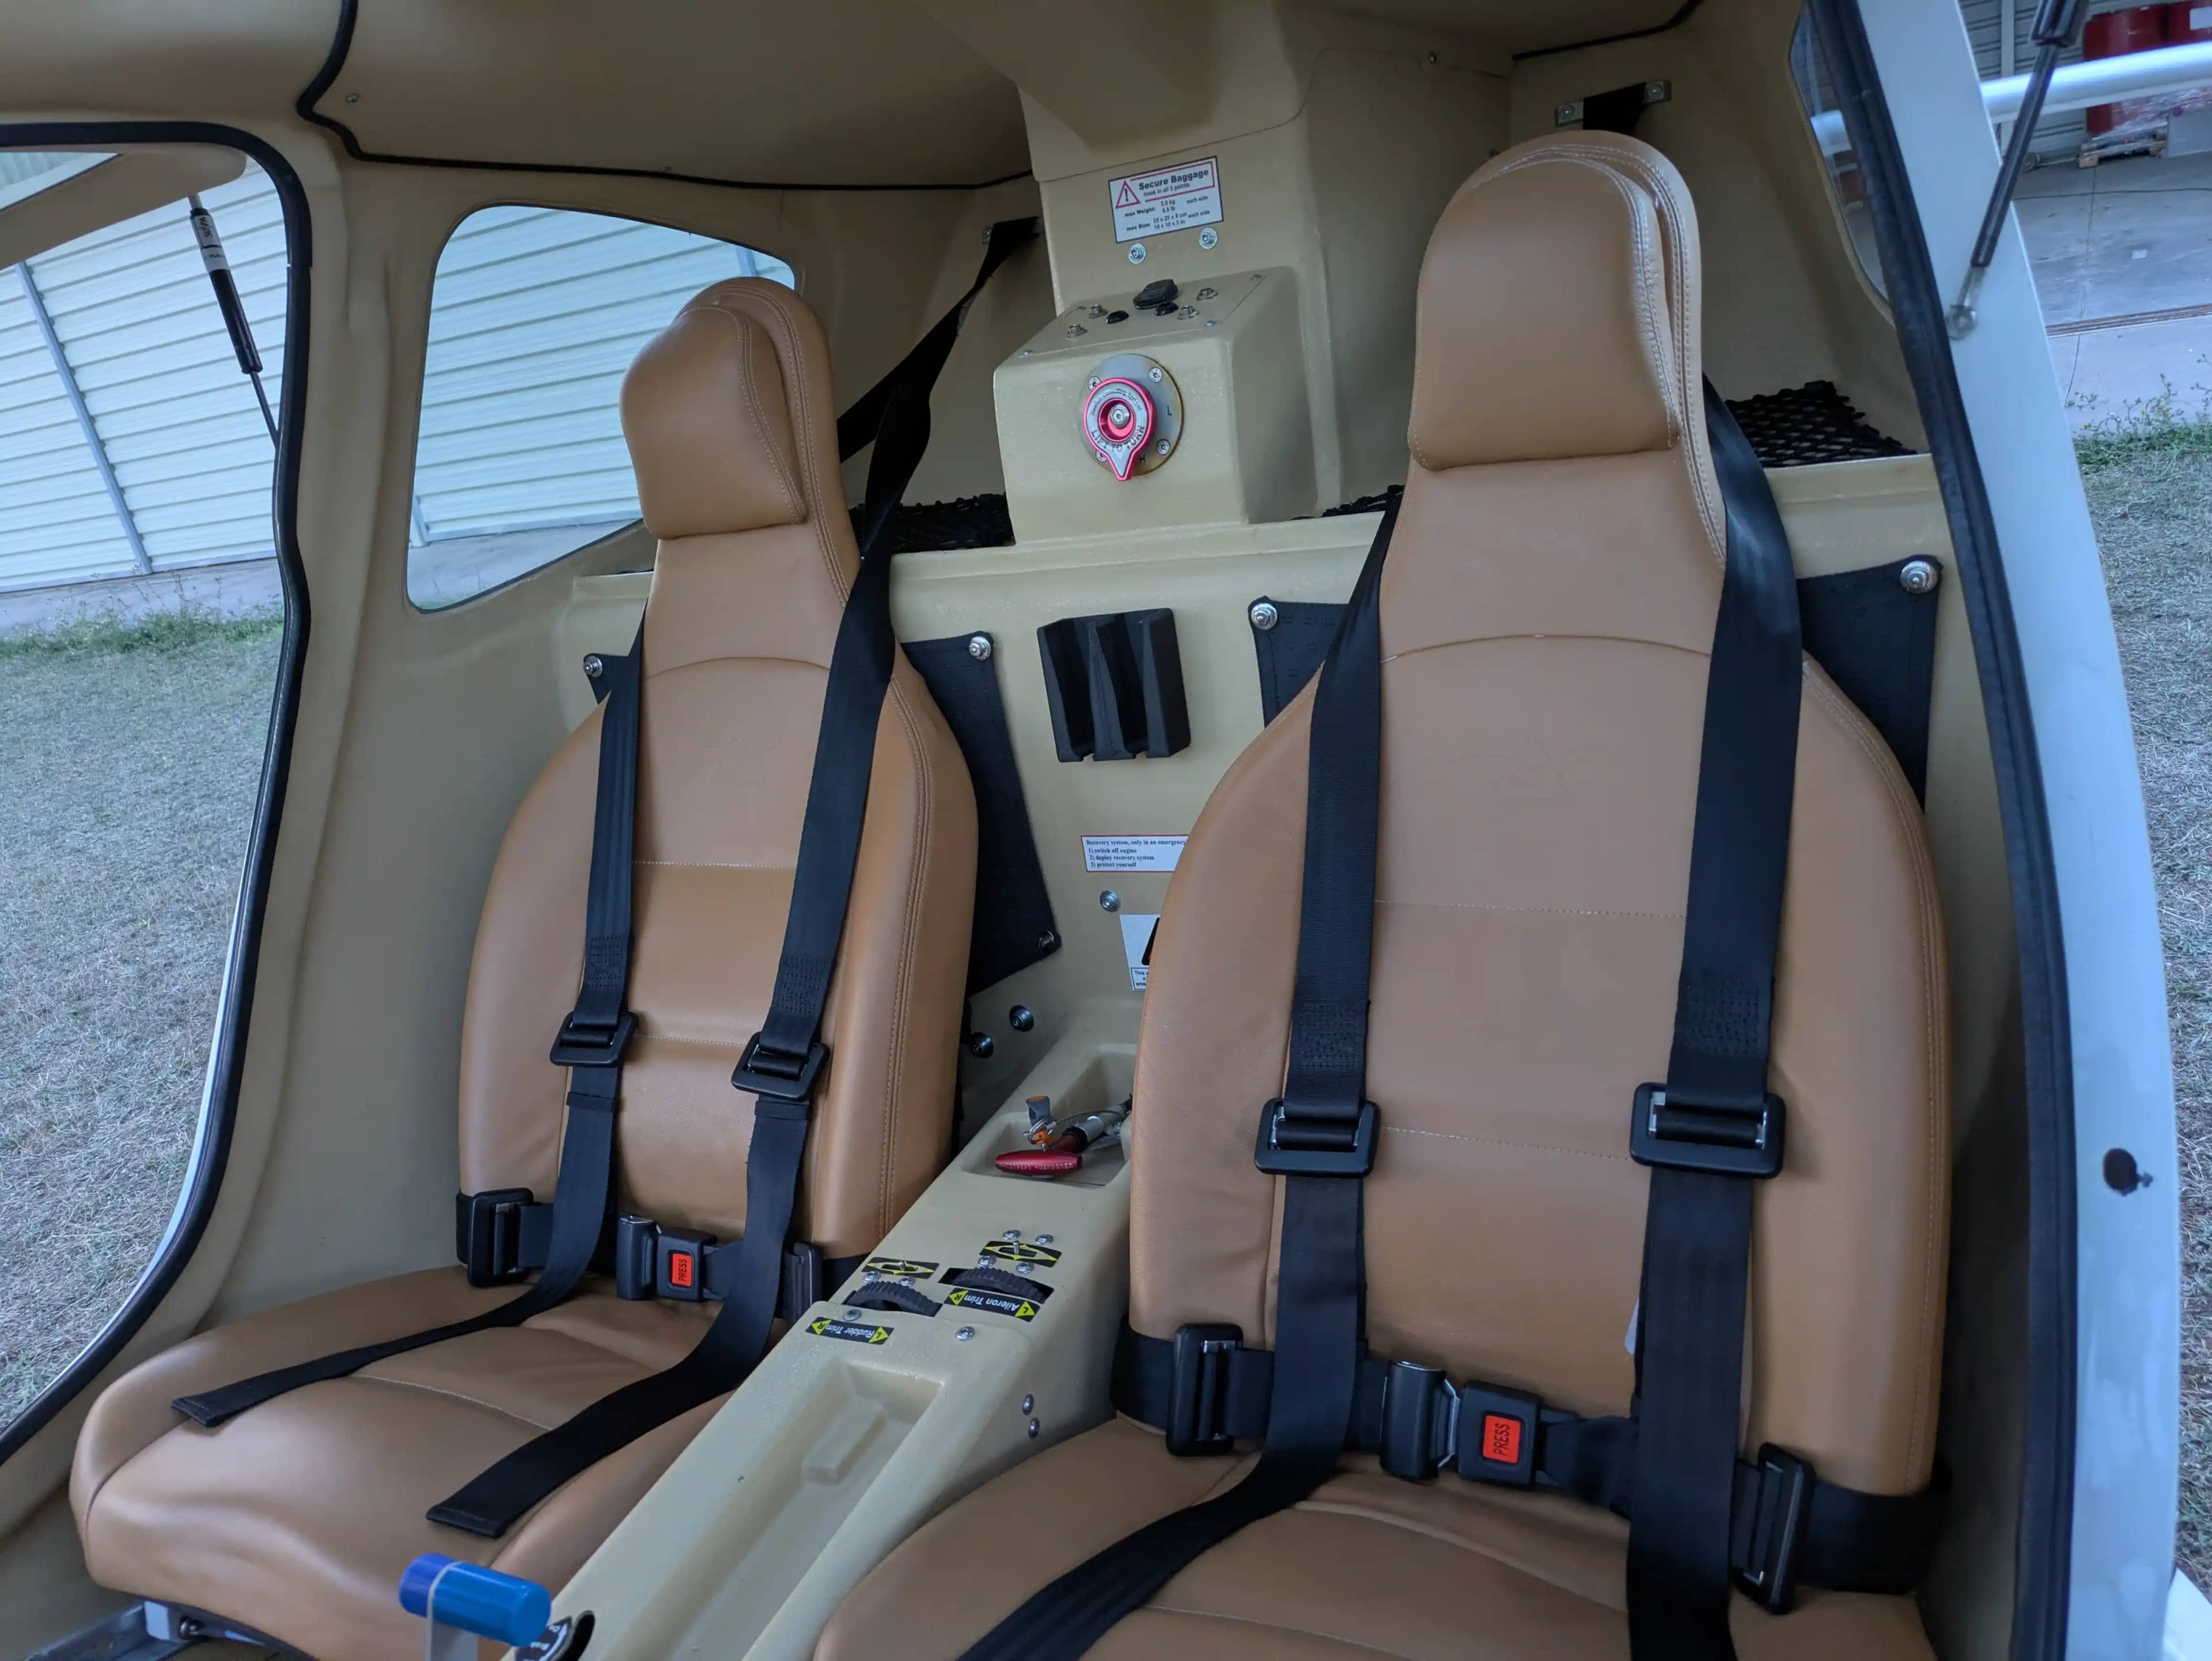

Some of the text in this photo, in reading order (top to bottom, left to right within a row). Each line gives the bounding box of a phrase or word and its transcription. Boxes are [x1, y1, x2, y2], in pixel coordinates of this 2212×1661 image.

[1139, 170, 1209, 190] Secure Baggage
[1092, 429, 1109, 449] LIFT
[1124, 425, 1145, 449] TURN
[678, 1258, 687, 1282] PRESS
[964, 1295, 984, 1305] Trim
[986, 1299, 1020, 1311] Aileron
[825, 1325, 844, 1334] Trim
[843, 1327, 876, 1338] Rudder
[1493, 1422, 1510, 1456] PRESS
